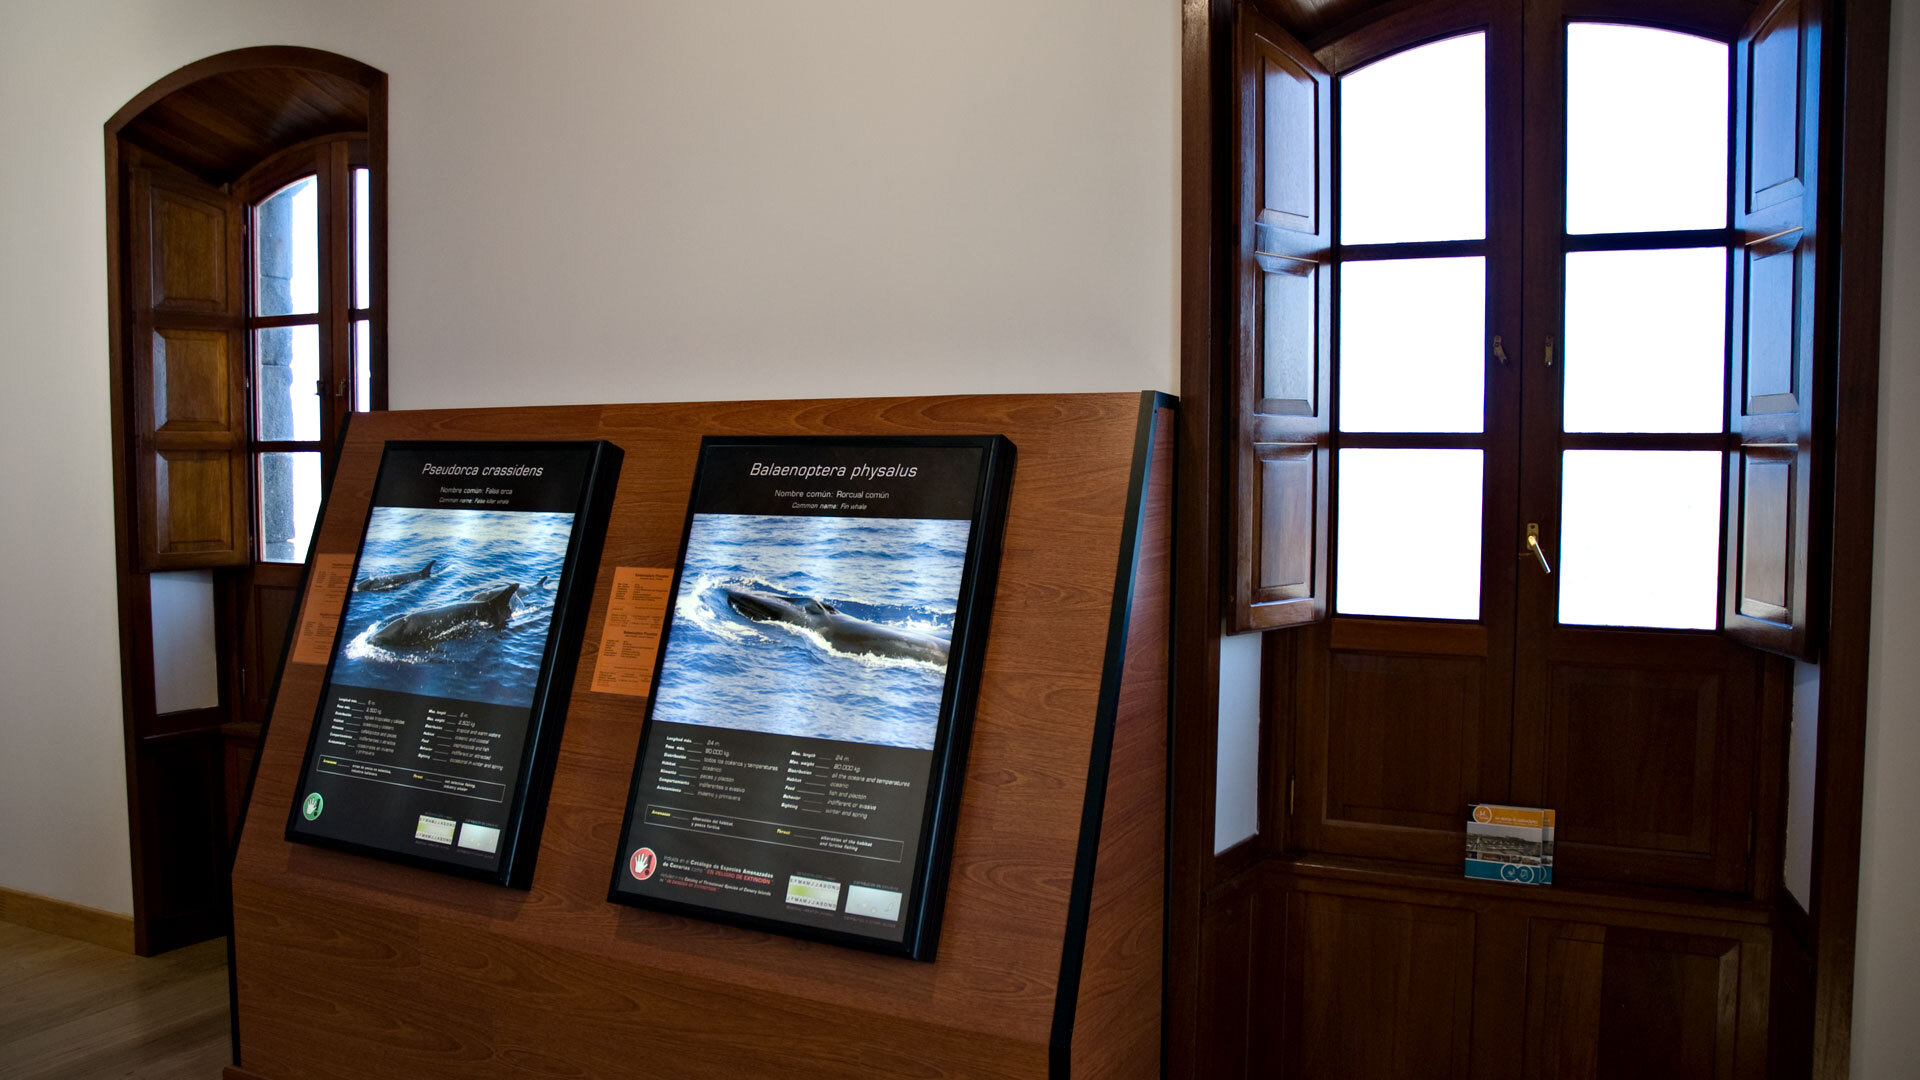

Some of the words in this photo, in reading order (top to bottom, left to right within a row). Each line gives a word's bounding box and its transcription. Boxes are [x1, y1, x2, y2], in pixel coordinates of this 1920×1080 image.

[422, 463, 479, 475] Pseudorca
[482, 464, 543, 476] crassidens
[750, 463, 846, 479] Balaenoptera
[850, 464, 918, 480] physalus
